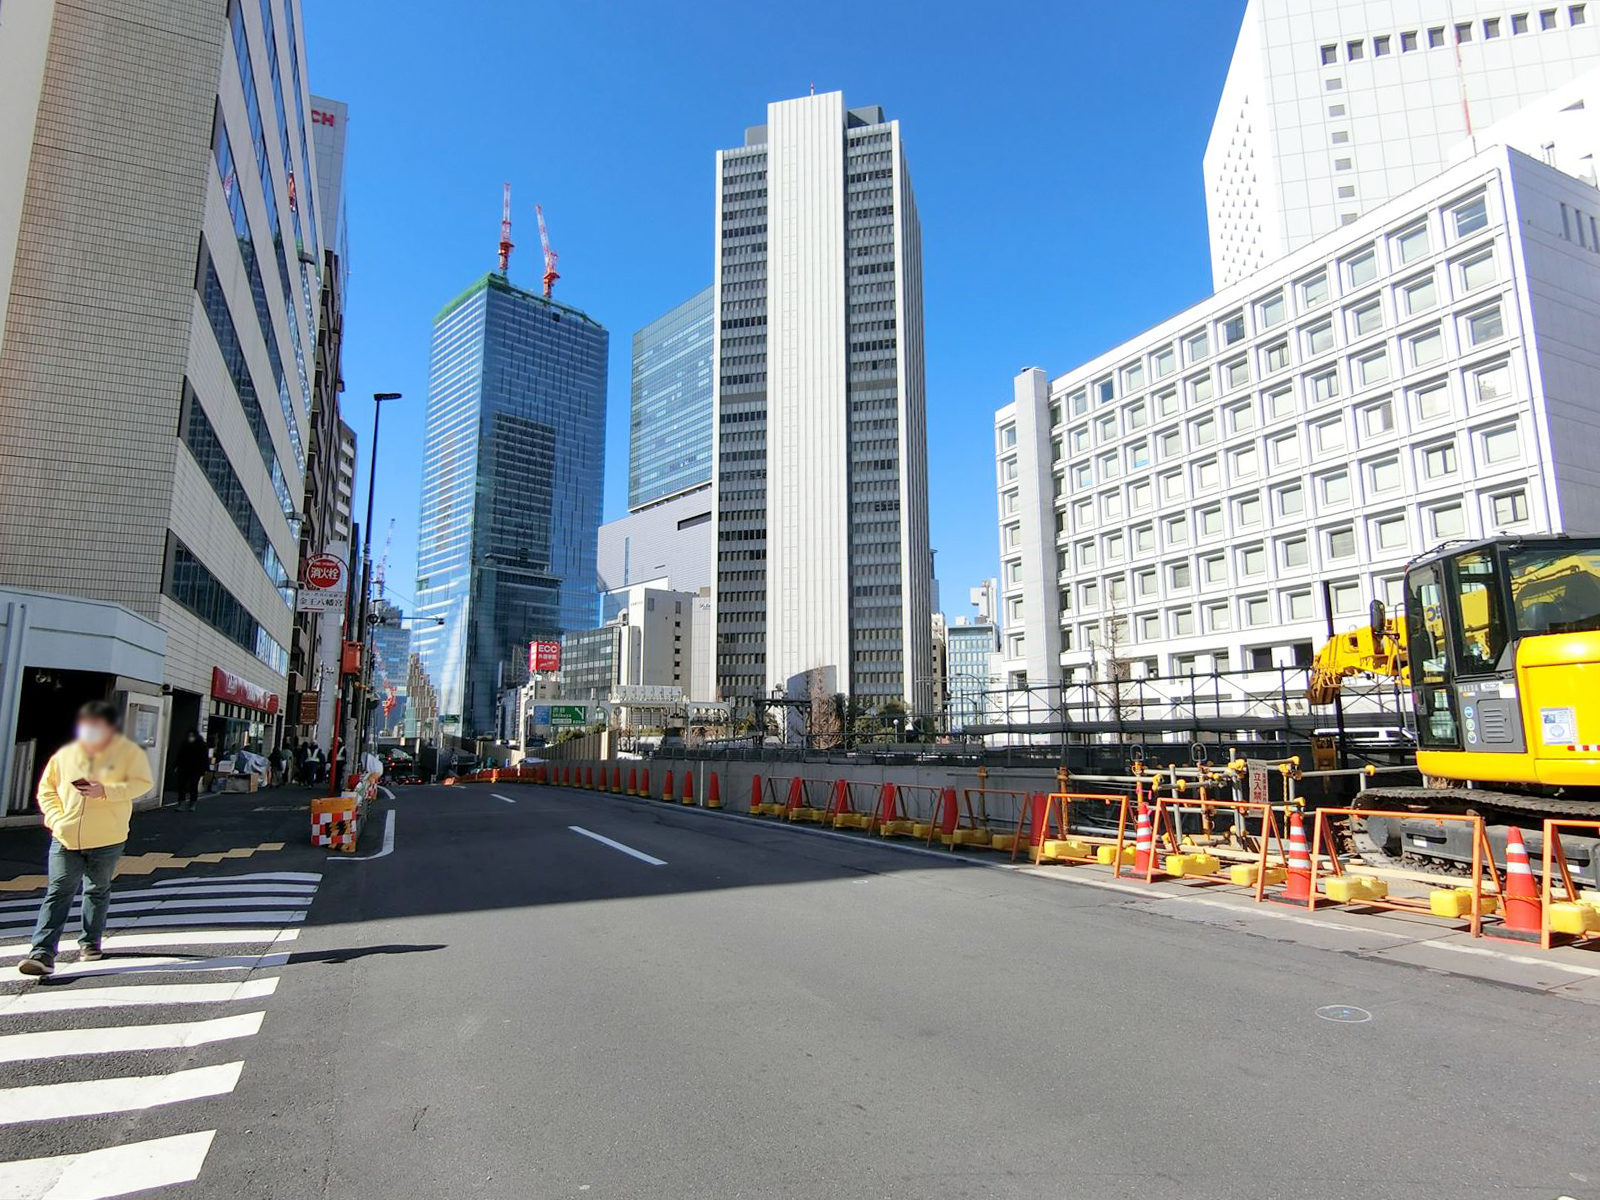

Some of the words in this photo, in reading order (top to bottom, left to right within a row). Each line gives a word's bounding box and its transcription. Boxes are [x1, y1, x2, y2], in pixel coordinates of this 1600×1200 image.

[311, 567, 339, 580] 消火栓
[538, 645, 558, 653] ECC
[1253, 772, 1262, 804] 立入禁
